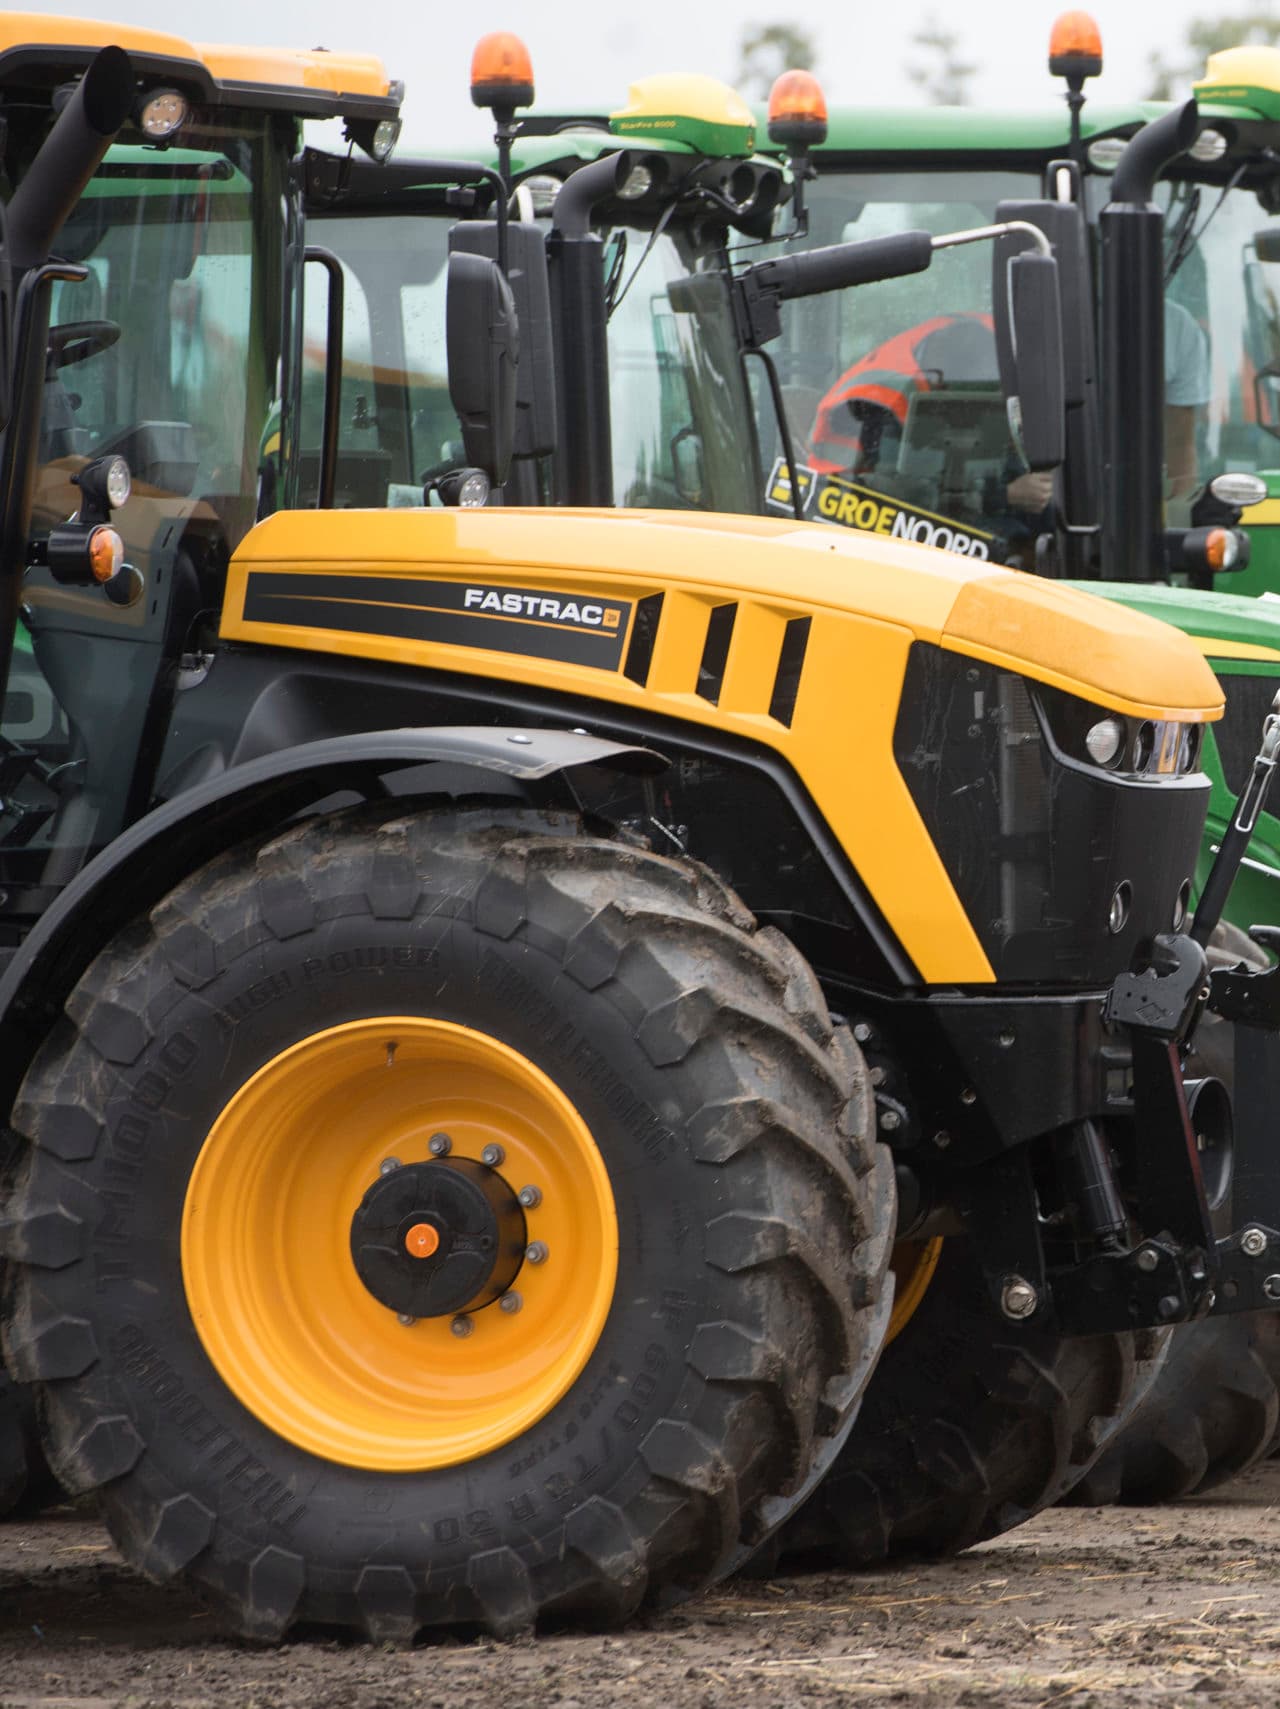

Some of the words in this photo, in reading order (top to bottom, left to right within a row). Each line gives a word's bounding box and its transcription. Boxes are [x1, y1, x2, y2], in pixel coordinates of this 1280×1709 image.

[817, 486, 989, 562] GROENOORD
[463, 588, 603, 625] FASTRAC
[301, 945, 440, 984] POWER
